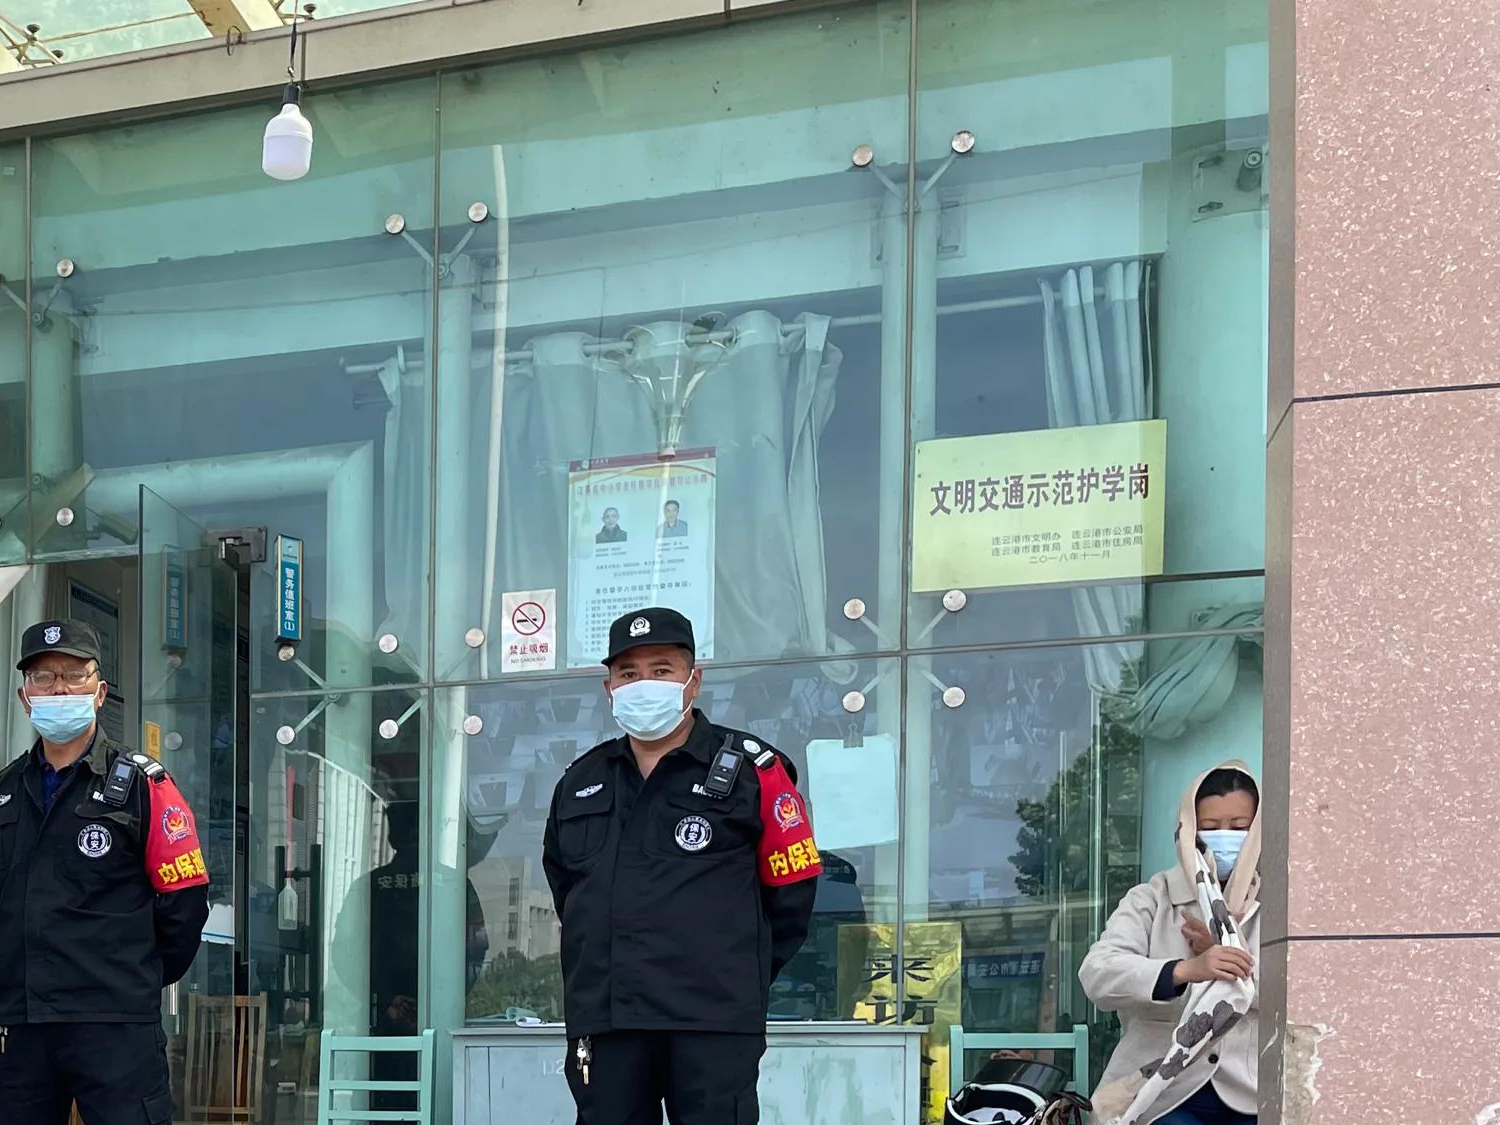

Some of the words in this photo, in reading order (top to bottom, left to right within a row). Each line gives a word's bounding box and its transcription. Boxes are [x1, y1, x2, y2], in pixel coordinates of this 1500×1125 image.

[929, 463, 1149, 517] 文明交通示范护学岗
[509, 642, 549, 656] 禁止吸烟
